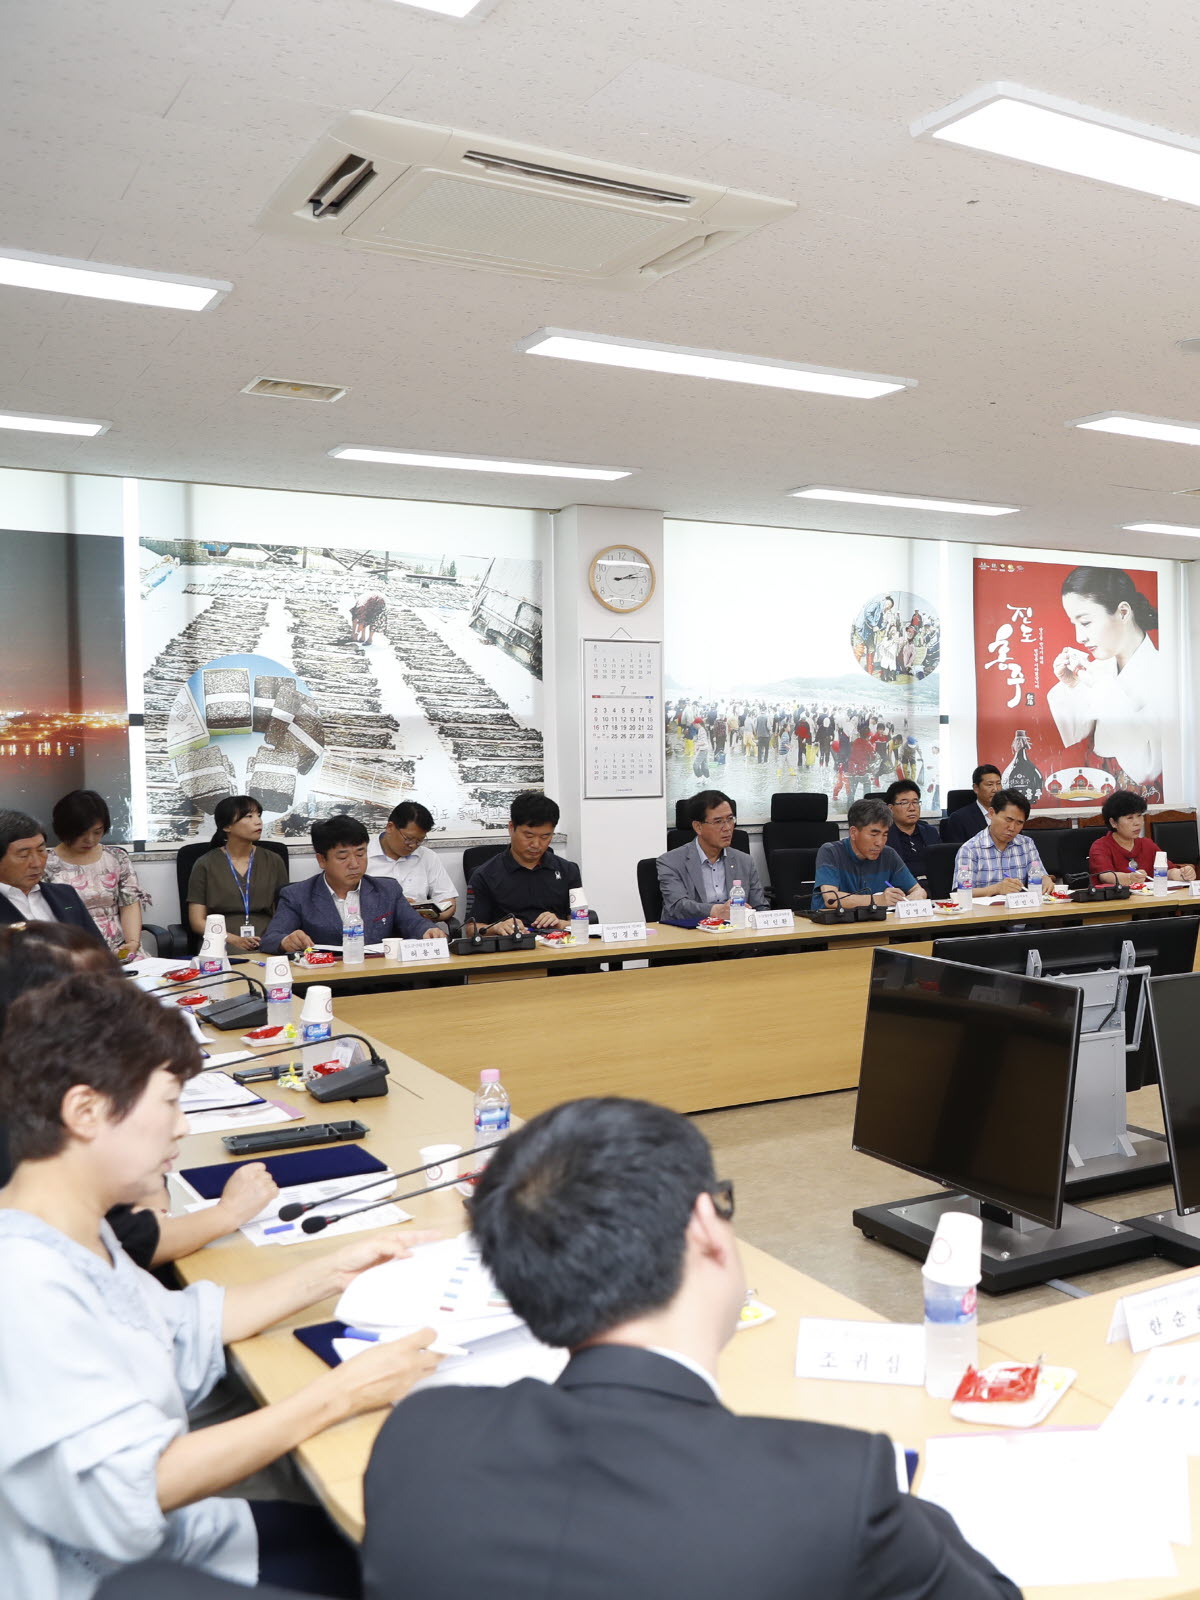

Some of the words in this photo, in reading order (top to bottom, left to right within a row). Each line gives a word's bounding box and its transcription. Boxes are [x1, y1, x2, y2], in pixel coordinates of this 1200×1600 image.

[1006, 603, 1037, 643] 진도
[984, 623, 1025, 708] 홍주
[619, 686, 627, 694] 7
